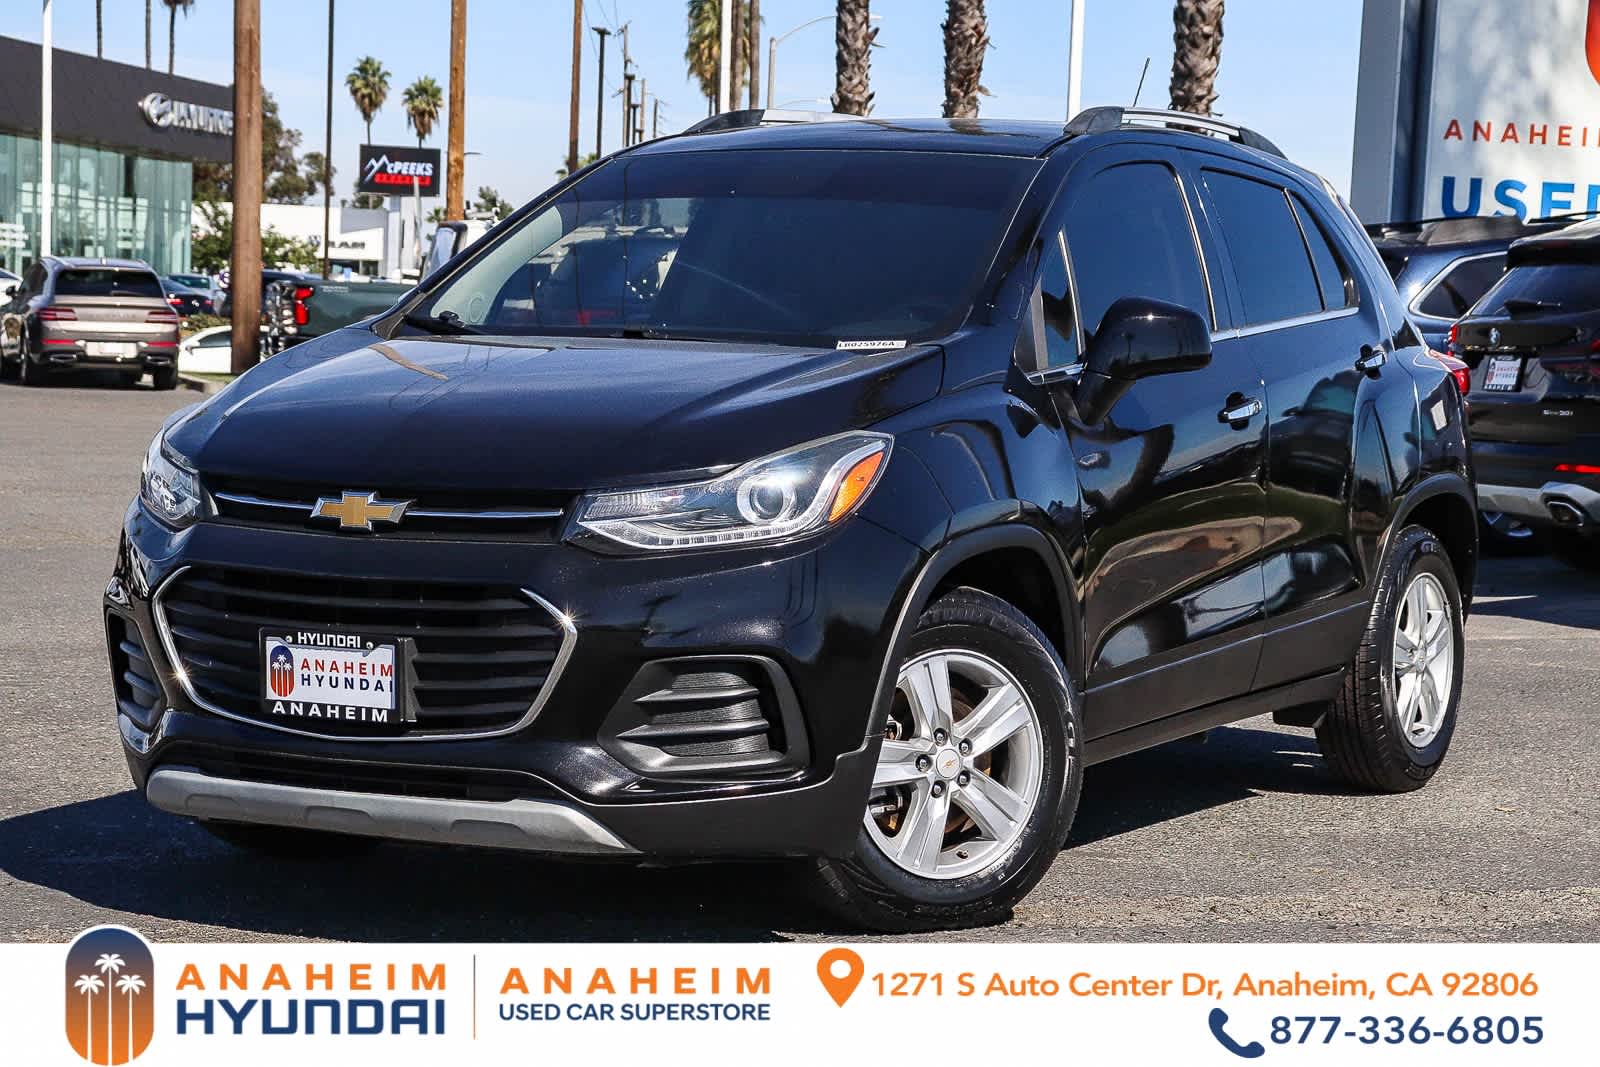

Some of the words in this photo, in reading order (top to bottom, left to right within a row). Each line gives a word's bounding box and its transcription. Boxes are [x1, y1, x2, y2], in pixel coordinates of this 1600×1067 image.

[1443, 118, 1600, 147] ANAHEI
[297, 631, 361, 649] HYUNDAI
[301, 657, 393, 678] ANAHEIM
[301, 673, 393, 693] HYUNDAI
[272, 700, 388, 723] ANAHEIM
